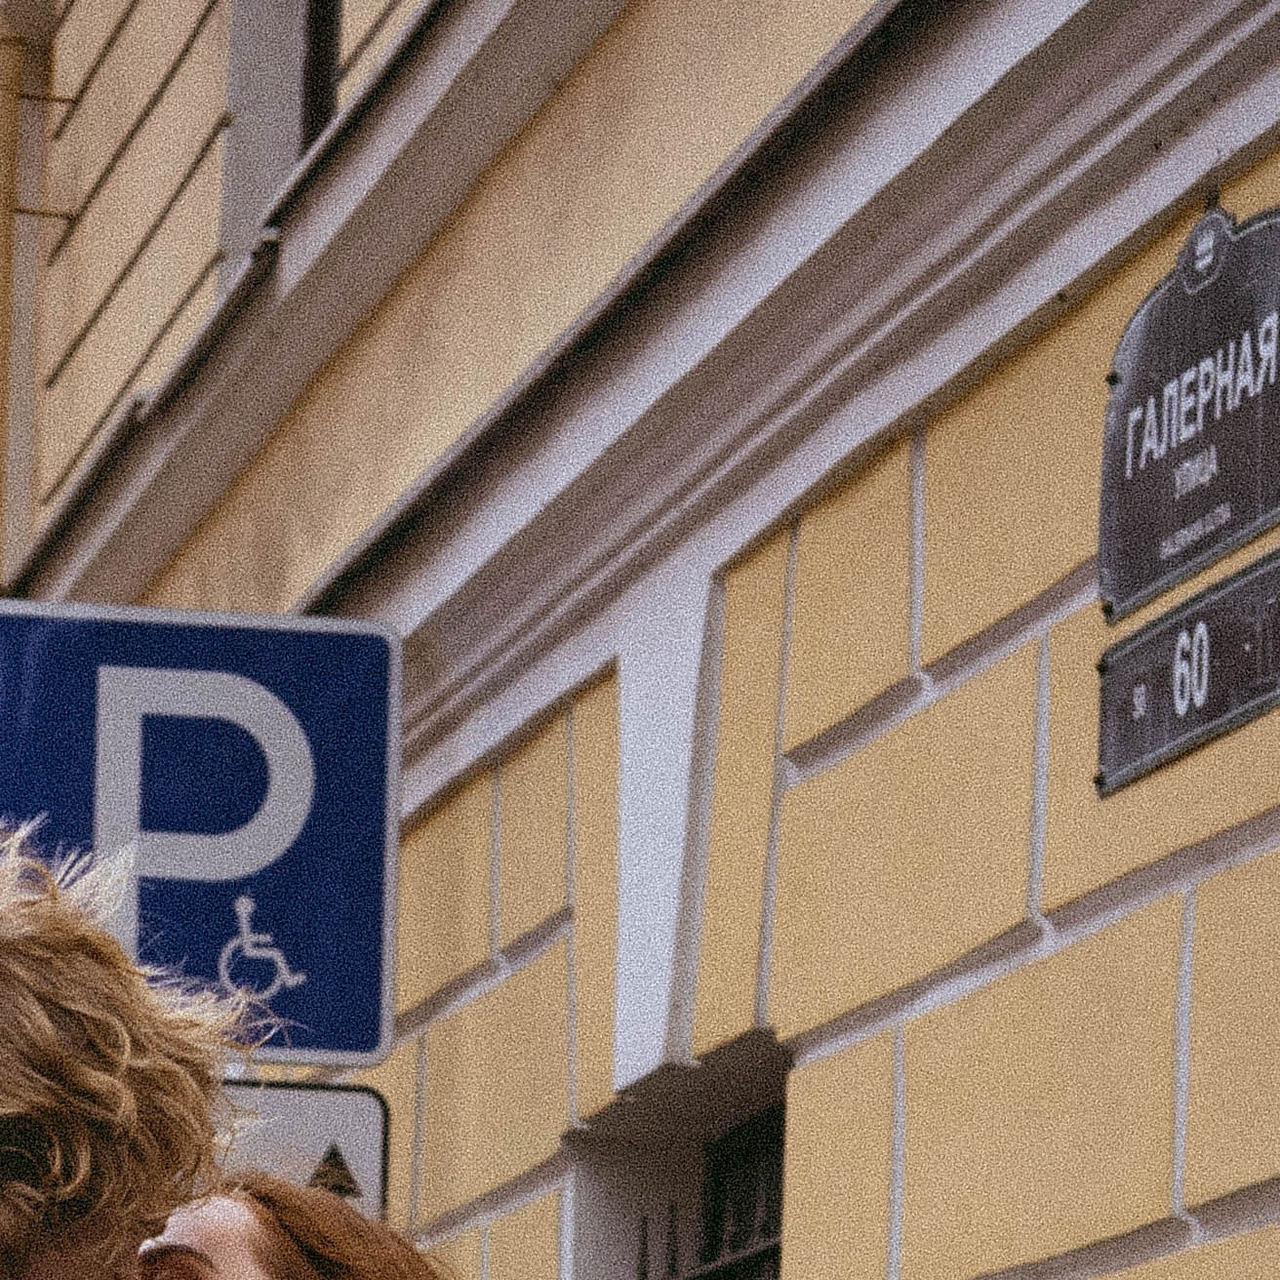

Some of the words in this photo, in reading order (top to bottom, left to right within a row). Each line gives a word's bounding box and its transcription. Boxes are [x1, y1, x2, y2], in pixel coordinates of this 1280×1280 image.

[1126, 313, 1278, 480] ГАЛЕРНАЯ
[1174, 620, 1210, 716] 60
[95, 667, 315, 958] P
